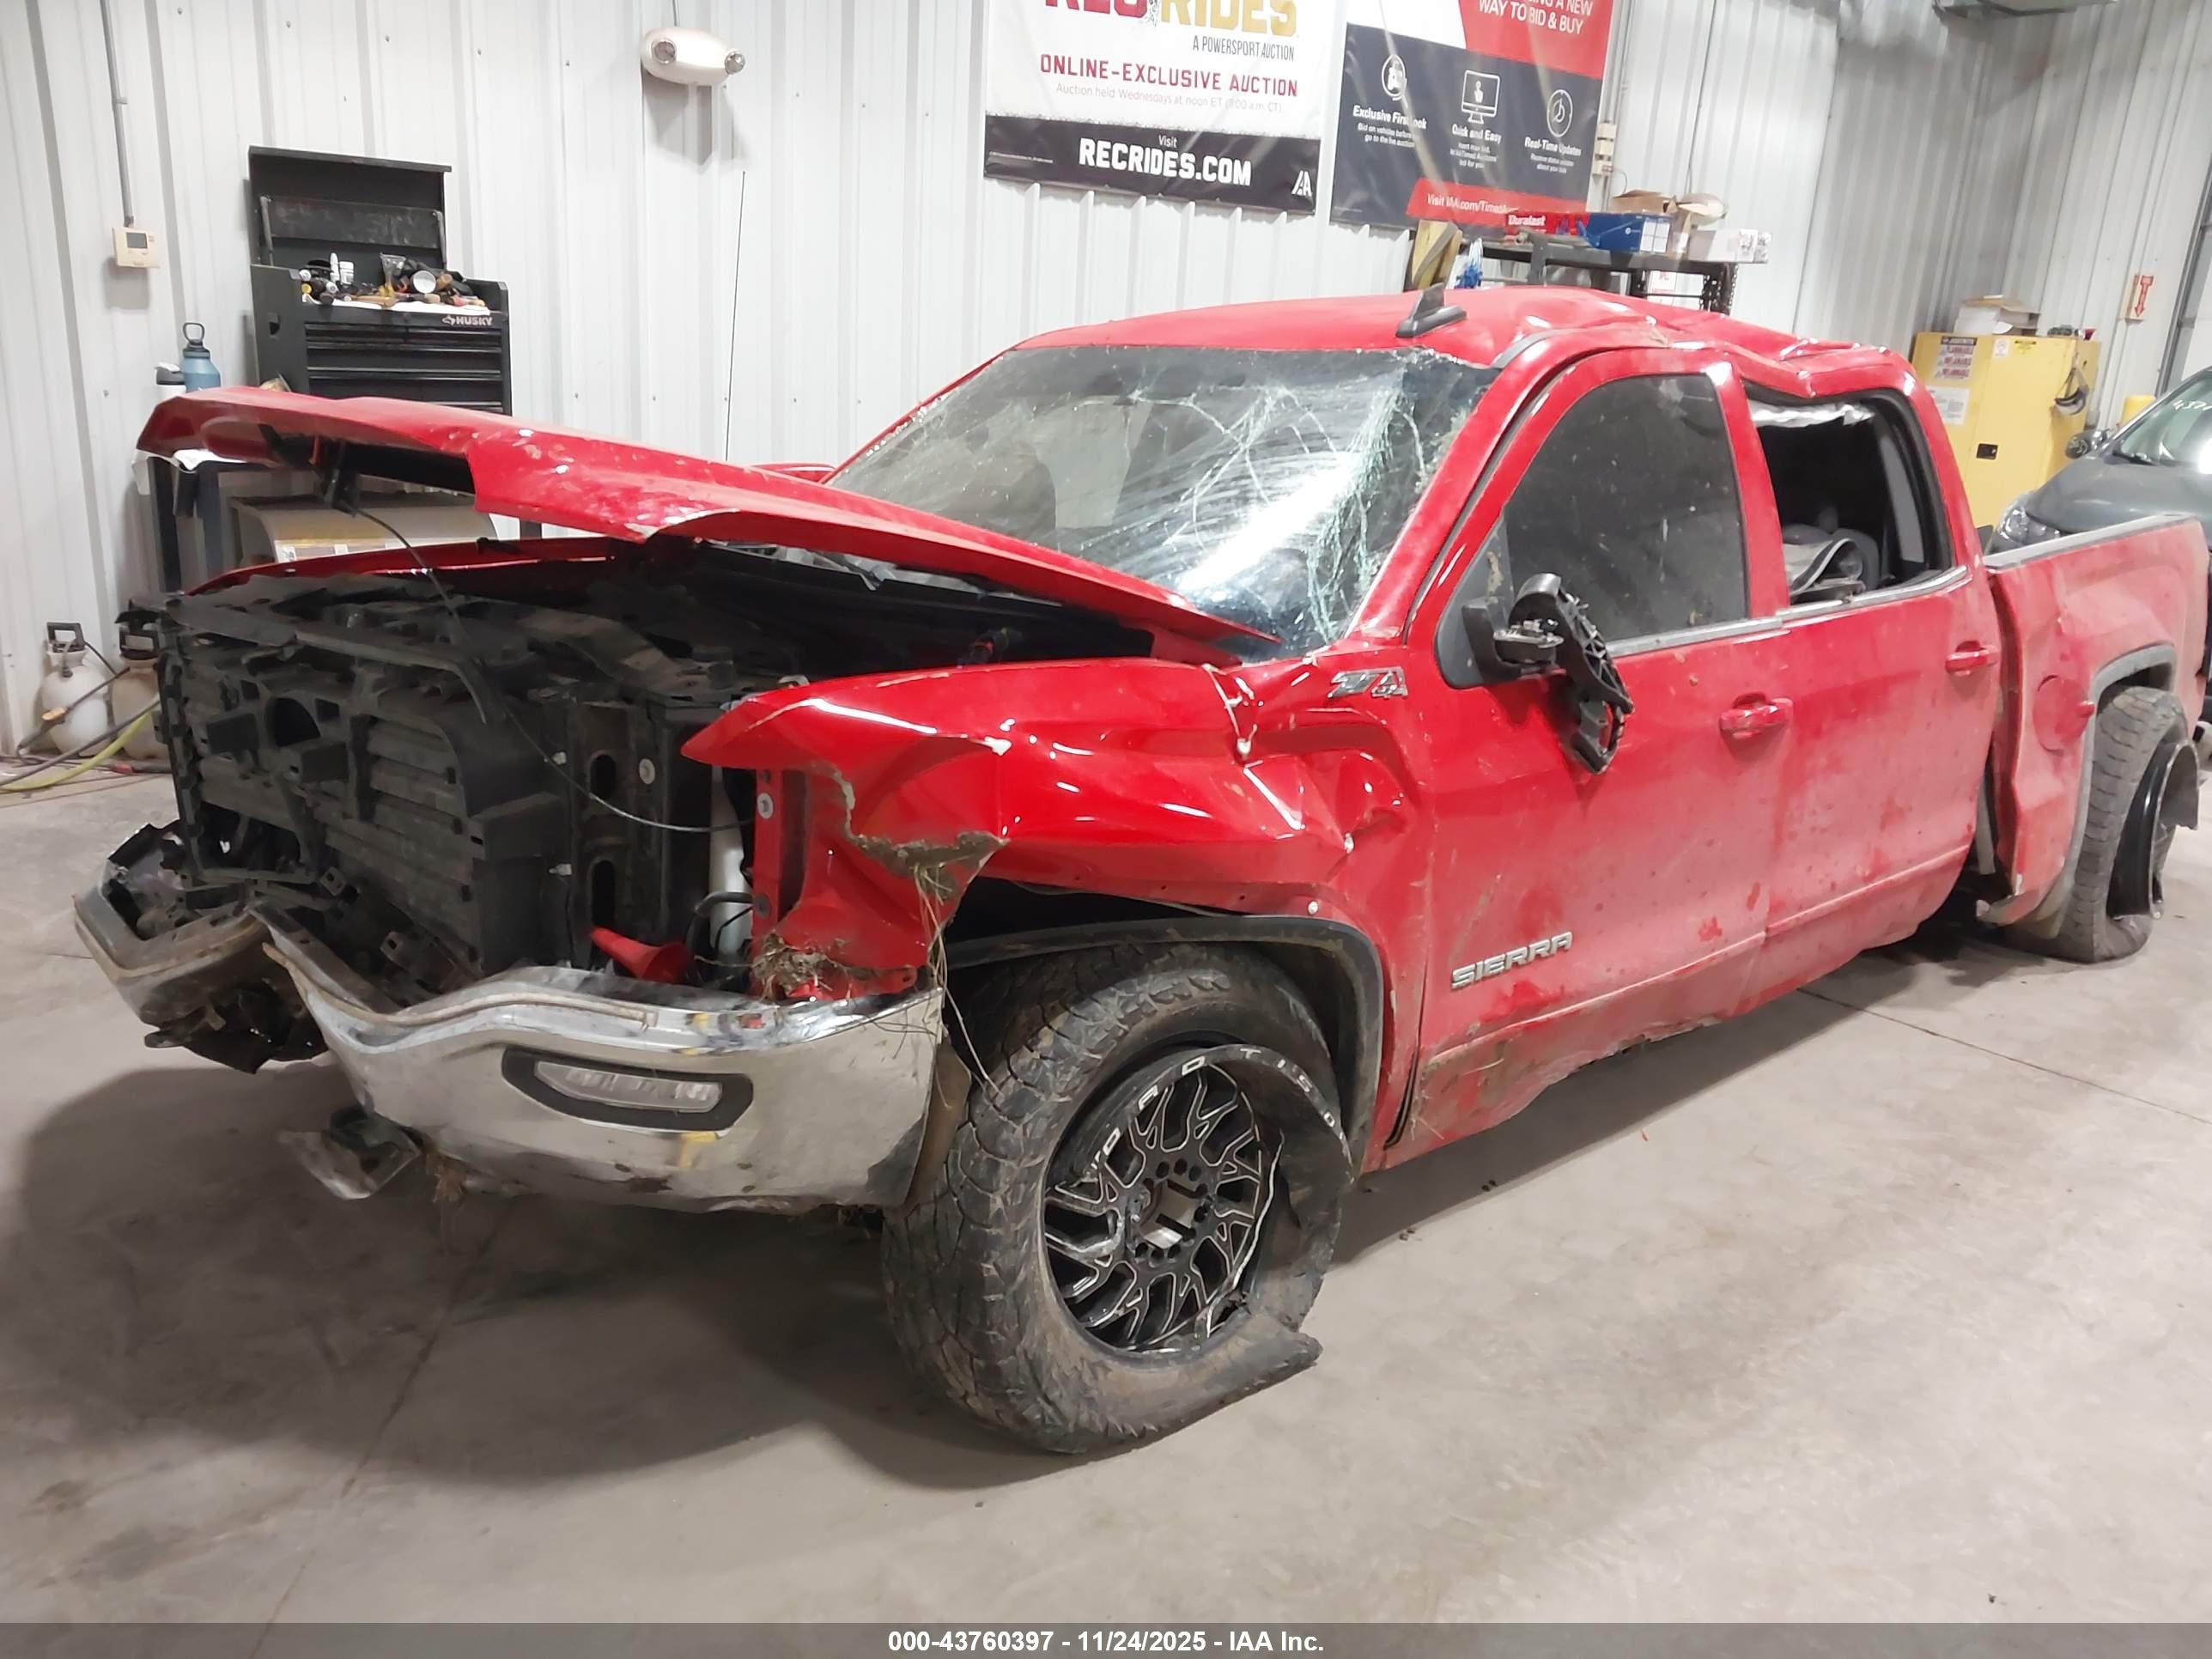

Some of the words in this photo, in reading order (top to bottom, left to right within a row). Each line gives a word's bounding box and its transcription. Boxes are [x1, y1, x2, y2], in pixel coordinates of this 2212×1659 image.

[1479, 0, 1509, 17] WAY
[1510, 2, 1527, 21] TO
[1529, 7, 1546, 27] BID
[1548, 11, 1557, 29] &
[1559, 15, 1583, 35] BUY
[1566, 0, 1593, 16] NEW
[1193, 35, 1200, 52] A
[1202, 36, 1260, 58] POWERSPORT
[1261, 42, 1294, 62] AUCTION
[1041, 54, 1221, 90] ONLINE-EXCLUSIVE
[1230, 74, 1297, 97] AUCTION
[1056, 83, 1092, 95] Auction
[1096, 85, 1115, 98] held
[1352, 105, 1391, 123] Exclusive
[1159, 135, 1177, 148] Visit
[1452, 124, 1468, 137] Quick
[1469, 130, 1483, 140] and
[1485, 130, 1502, 144] Easy
[1079, 137, 1251, 186] RECRIDES.COM
[1428, 193, 1444, 206] Visit
[456, 315, 493, 325] HUSKY
[1451, 931, 1573, 990] SIERRA
